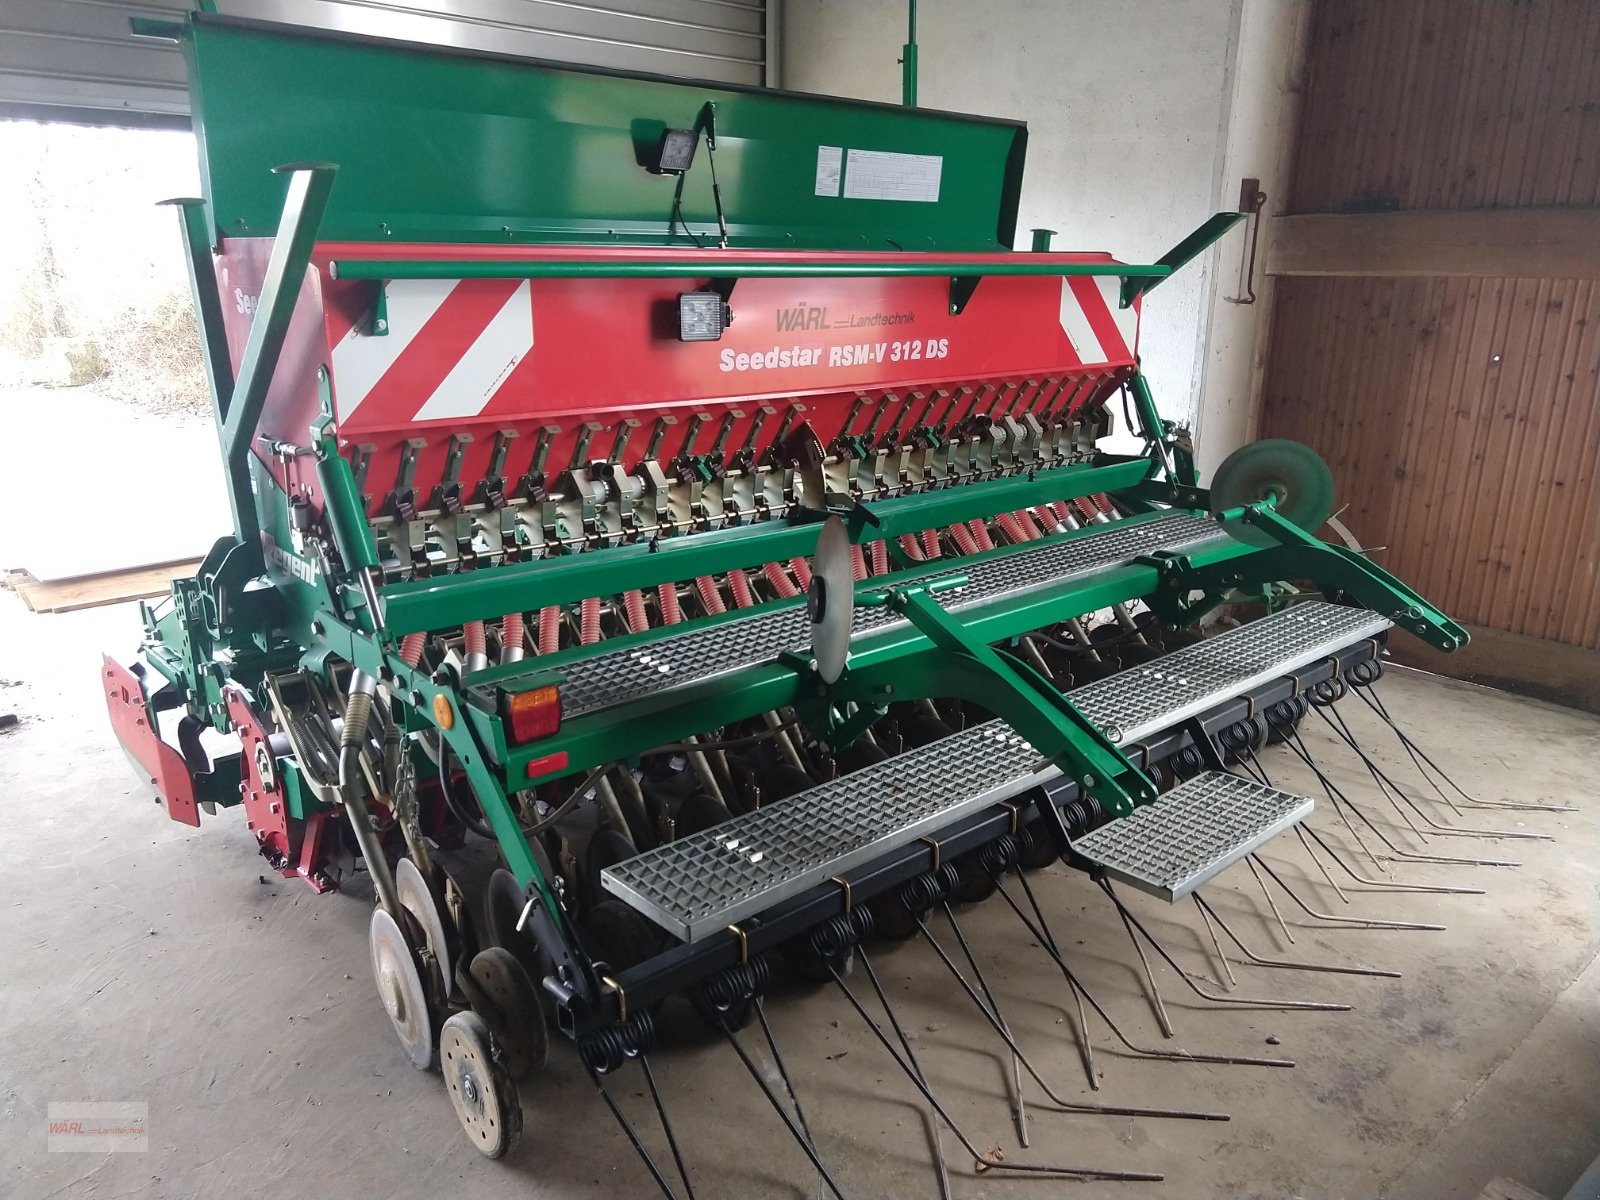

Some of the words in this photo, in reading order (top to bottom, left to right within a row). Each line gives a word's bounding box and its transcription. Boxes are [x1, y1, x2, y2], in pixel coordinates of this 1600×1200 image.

[234, 287, 260, 315] See
[776, 302, 831, 332] WÄRL
[850, 311, 915, 328] Landtechnik
[719, 345, 822, 372] Seedstar
[829, 343, 887, 367] RSM-V
[890, 340, 922, 362] 312
[925, 338, 949, 359] DS
